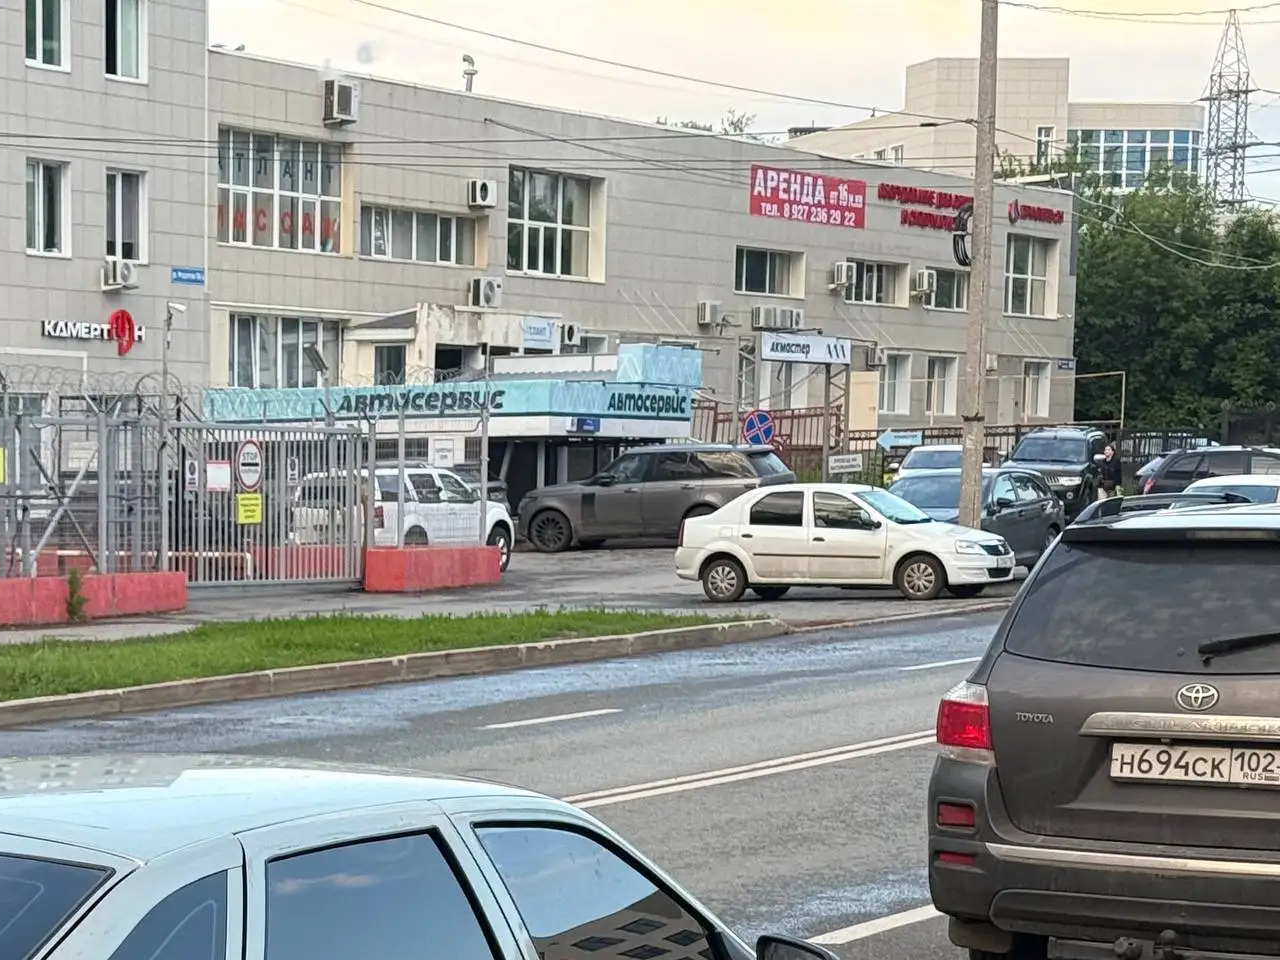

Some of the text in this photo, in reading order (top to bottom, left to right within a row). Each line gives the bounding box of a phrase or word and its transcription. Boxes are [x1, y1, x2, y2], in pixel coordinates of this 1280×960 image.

[753, 169, 825, 205] АРЕНДА
[838, 184, 848, 206] 16
[761, 202, 855, 226] тел. 8 927 236 29 22
[607, 392, 687, 416] Автосервис
[1015, 712, 1054, 723] TOYOTA
[1119, 748, 1275, 779] Н694СК 102
[1242, 771, 1264, 781] RUS
